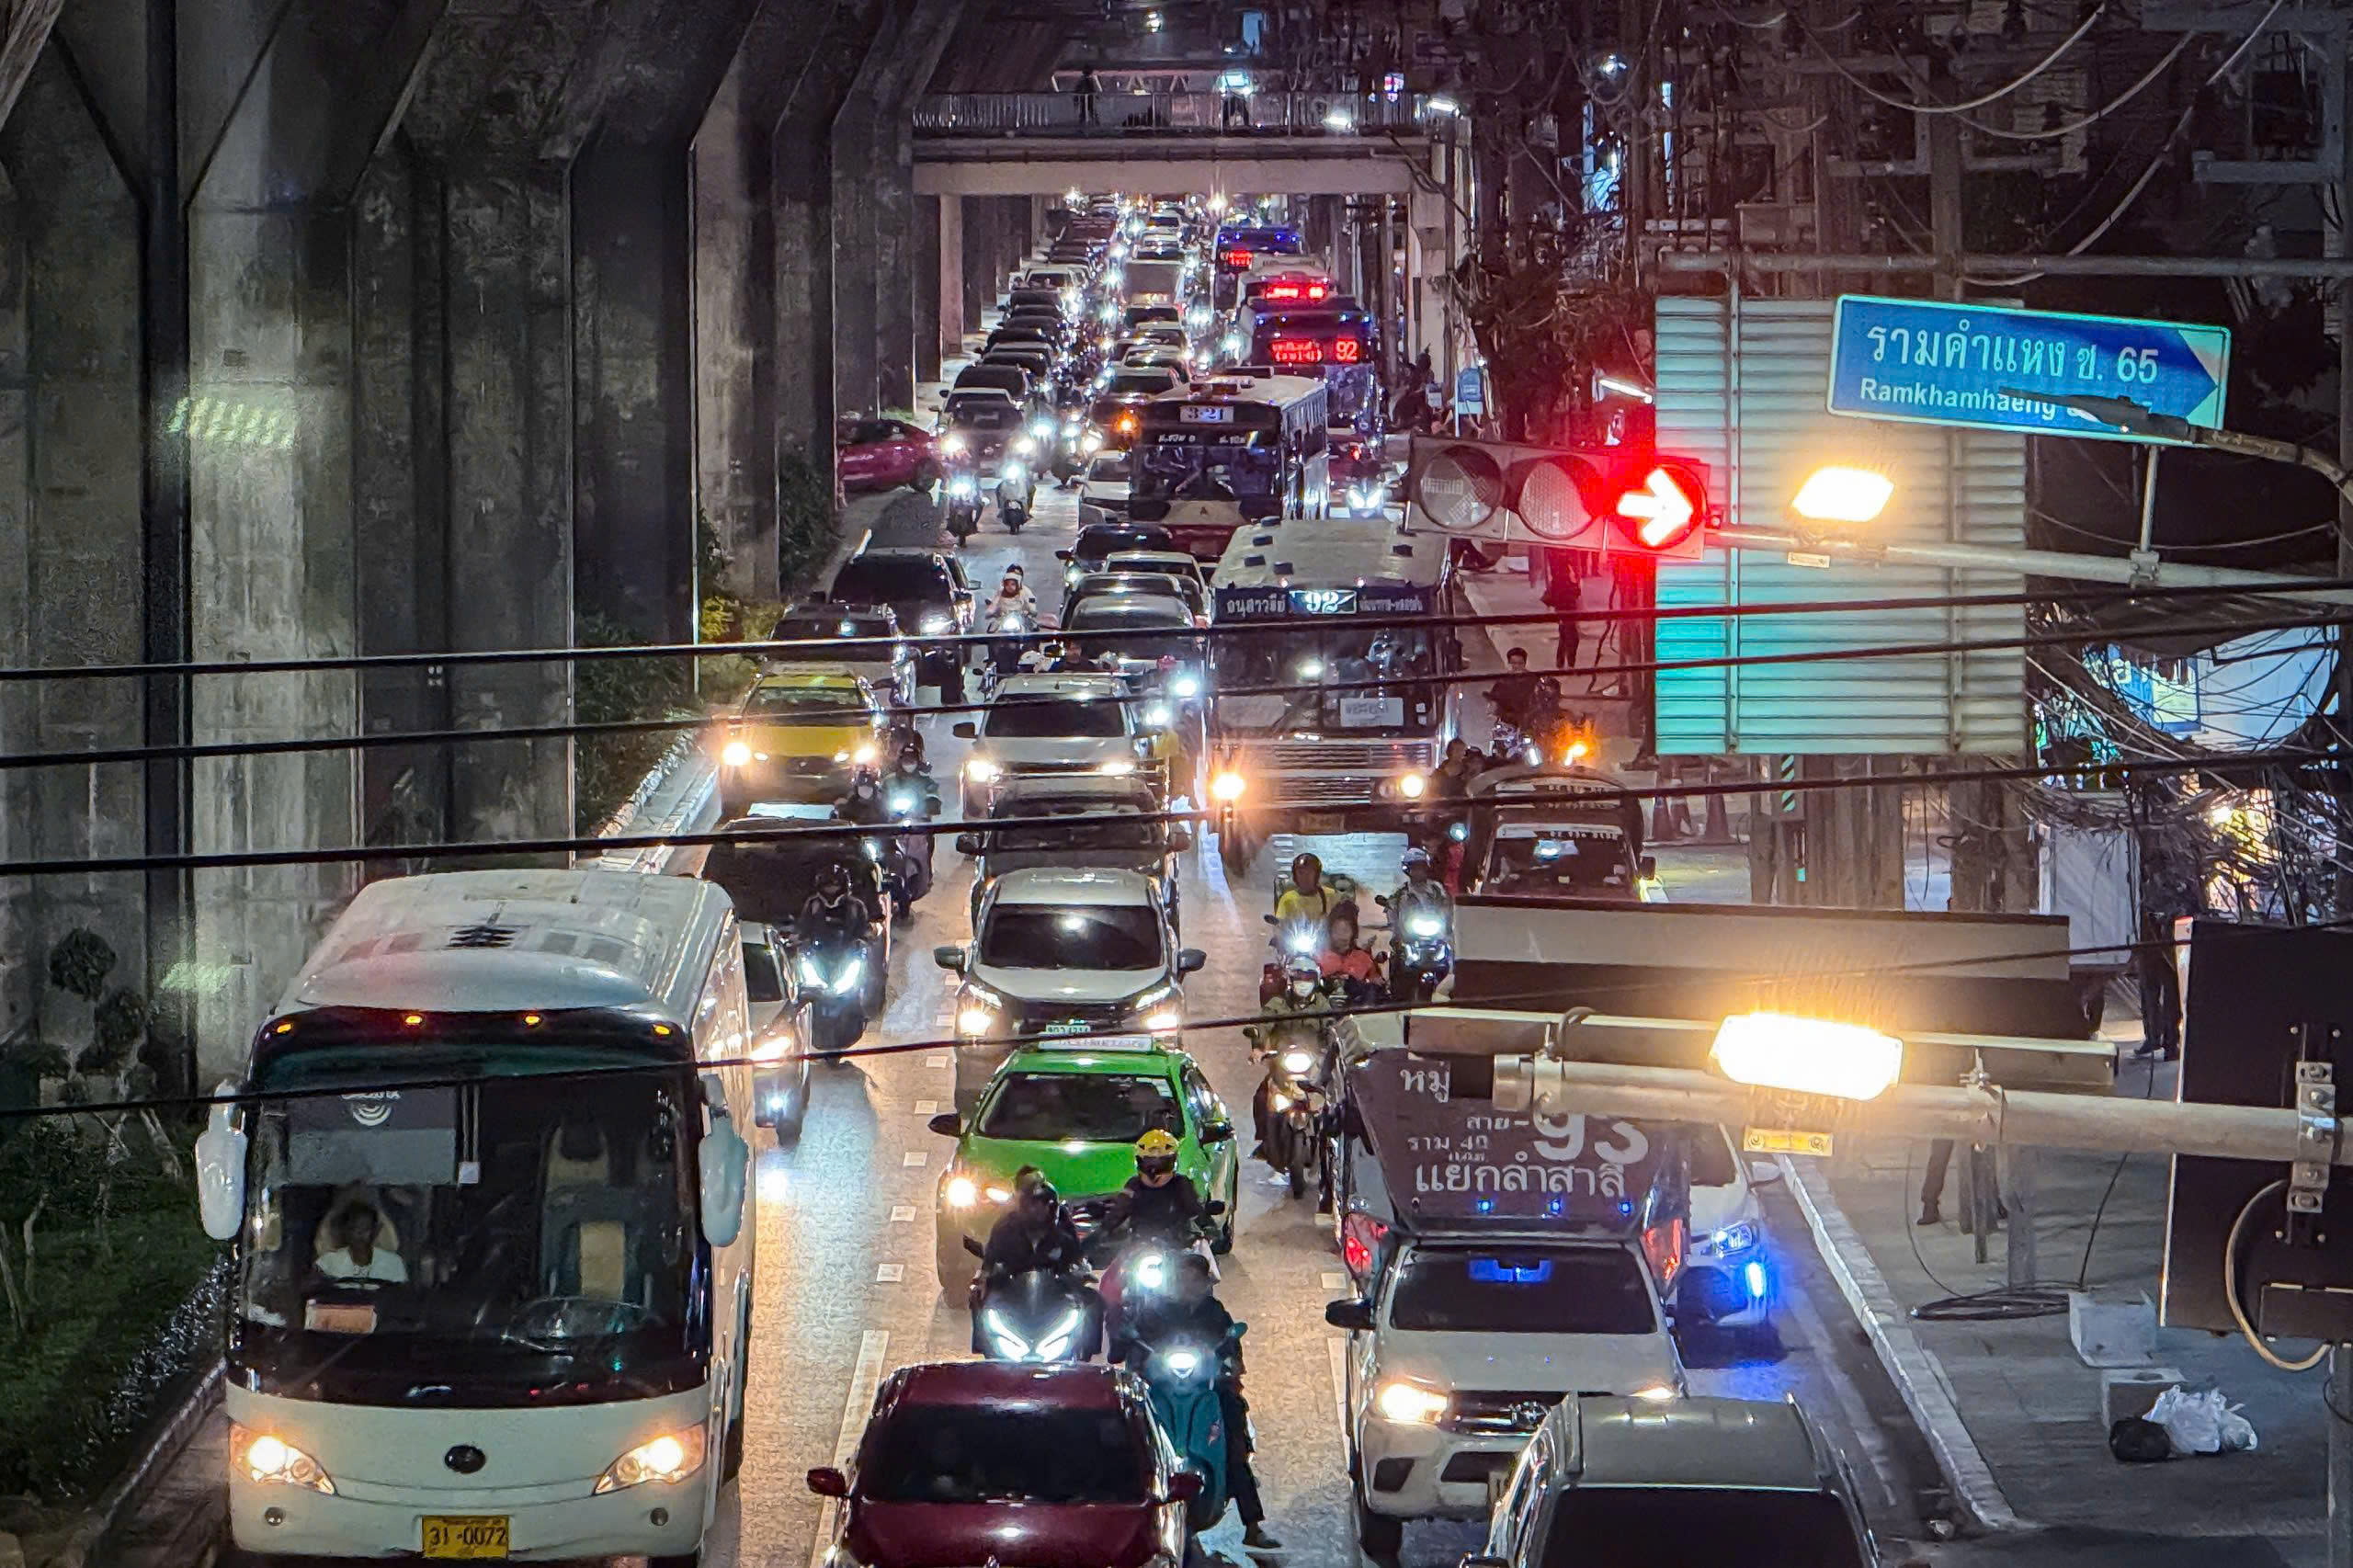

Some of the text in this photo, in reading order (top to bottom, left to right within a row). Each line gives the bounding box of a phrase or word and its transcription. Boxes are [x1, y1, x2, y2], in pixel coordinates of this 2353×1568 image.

[1336, 341, 1358, 362] 92
[1867, 318, 2065, 378] รามคำแหง
[2118, 346, 2159, 384] 65
[1304, 590, 1340, 614] 92
[1415, 1151, 1626, 1198] แยกลำสาลี
